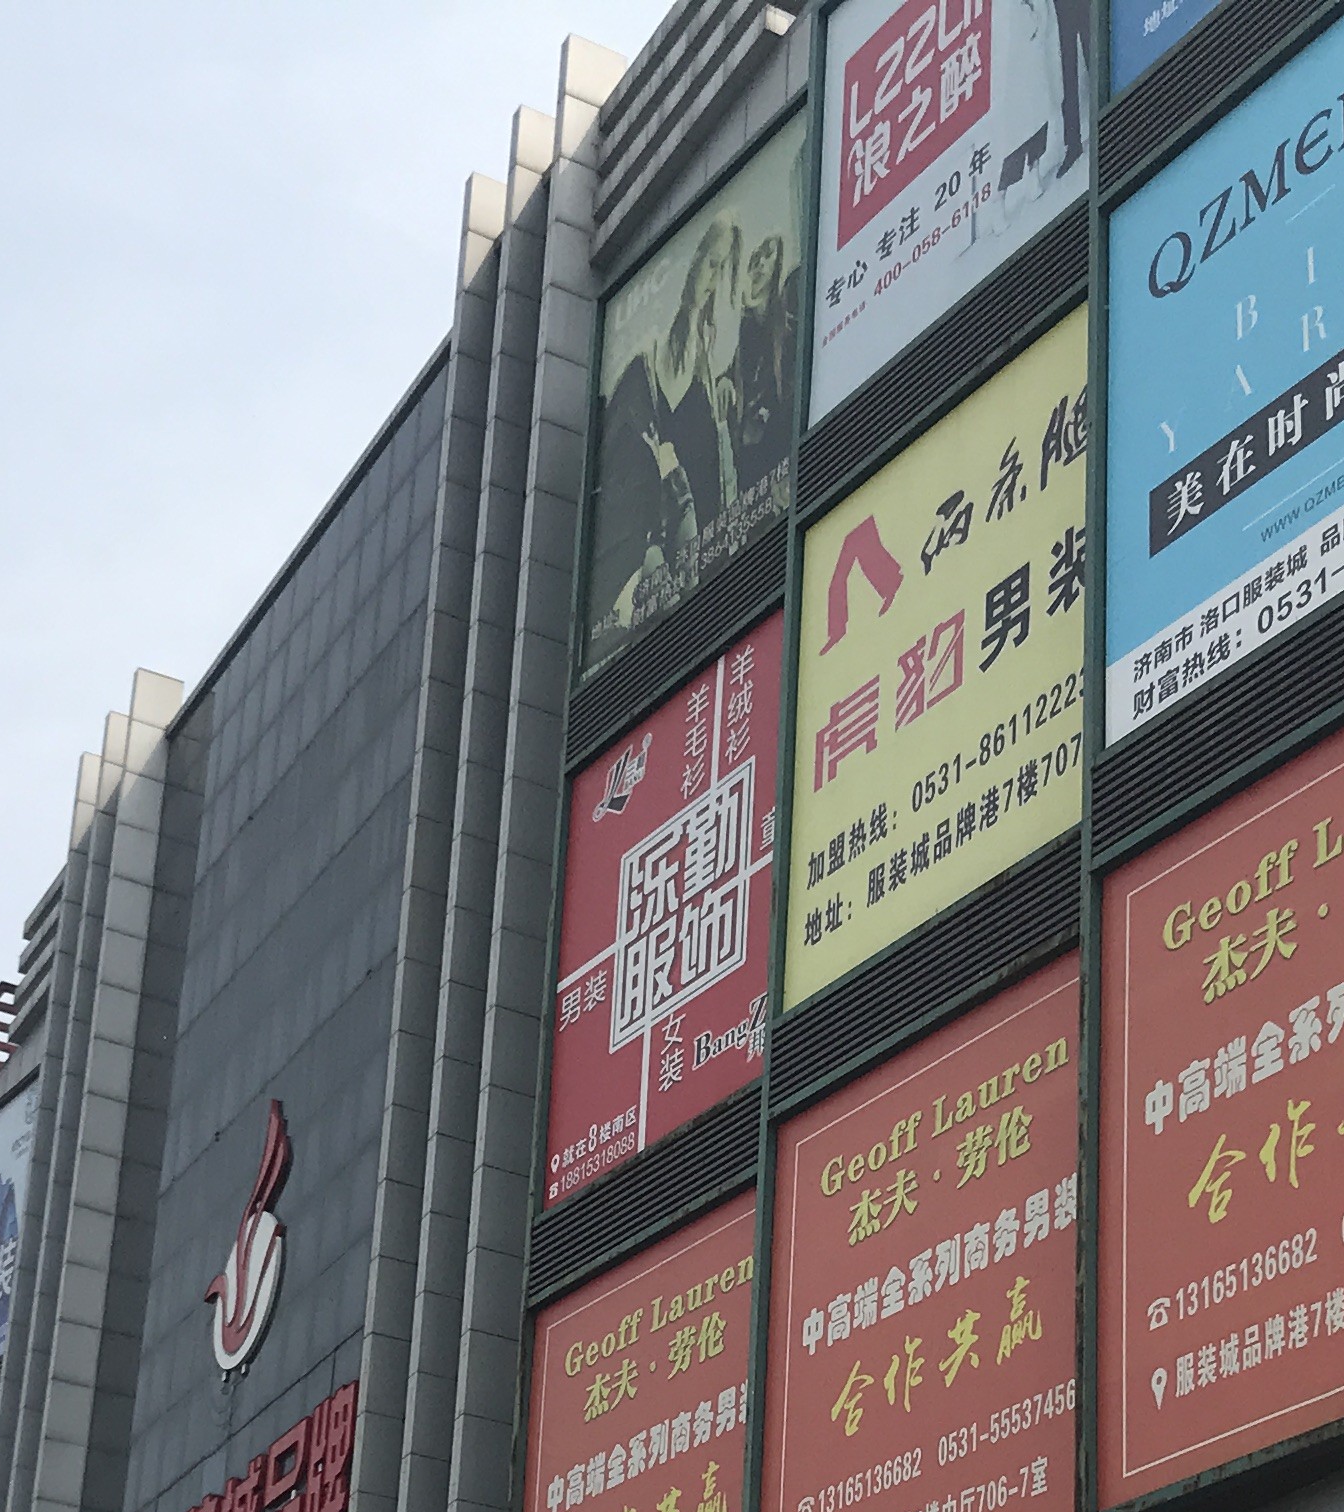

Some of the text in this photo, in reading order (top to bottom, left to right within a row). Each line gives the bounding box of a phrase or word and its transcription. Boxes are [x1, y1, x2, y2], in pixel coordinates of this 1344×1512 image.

[848, 31, 982, 208] 浪之醉
[825, 142, 992, 308] 专心 专注 20 年
[873, 181, 992, 297] 400-058-6118
[920, 386, 1087, 577] 两条腿
[1133, 626, 1193, 684] 济南市
[1199, 546, 1307, 636] 洛口服装城
[681, 684, 709, 800] 羊毛衫
[727, 644, 754, 767] 羊绒衫
[866, 731, 1082, 908] 服装城品牌港7楼707
[1162, 835, 1298, 950] Geoff
[559, 969, 607, 1033] 男装
[658, 1011, 686, 1093] 女装
[560, 1131, 636, 1192] 18815318088
[562, 1104, 637, 1169] 就在8楼南区
[820, 1036, 1070, 1197] Geoff Lauren
[847, 1105, 1034, 1247] 杰夫·劳伦
[564, 1254, 754, 1378] Geoff Lauren
[802, 1172, 1078, 1355] 中高端全系列商务男装
[1175, 1227, 1319, 1321] 13165136682
[830, 1276, 1043, 1437] 合作共赢
[938, 1378, 1076, 1467] 0531-55537456
